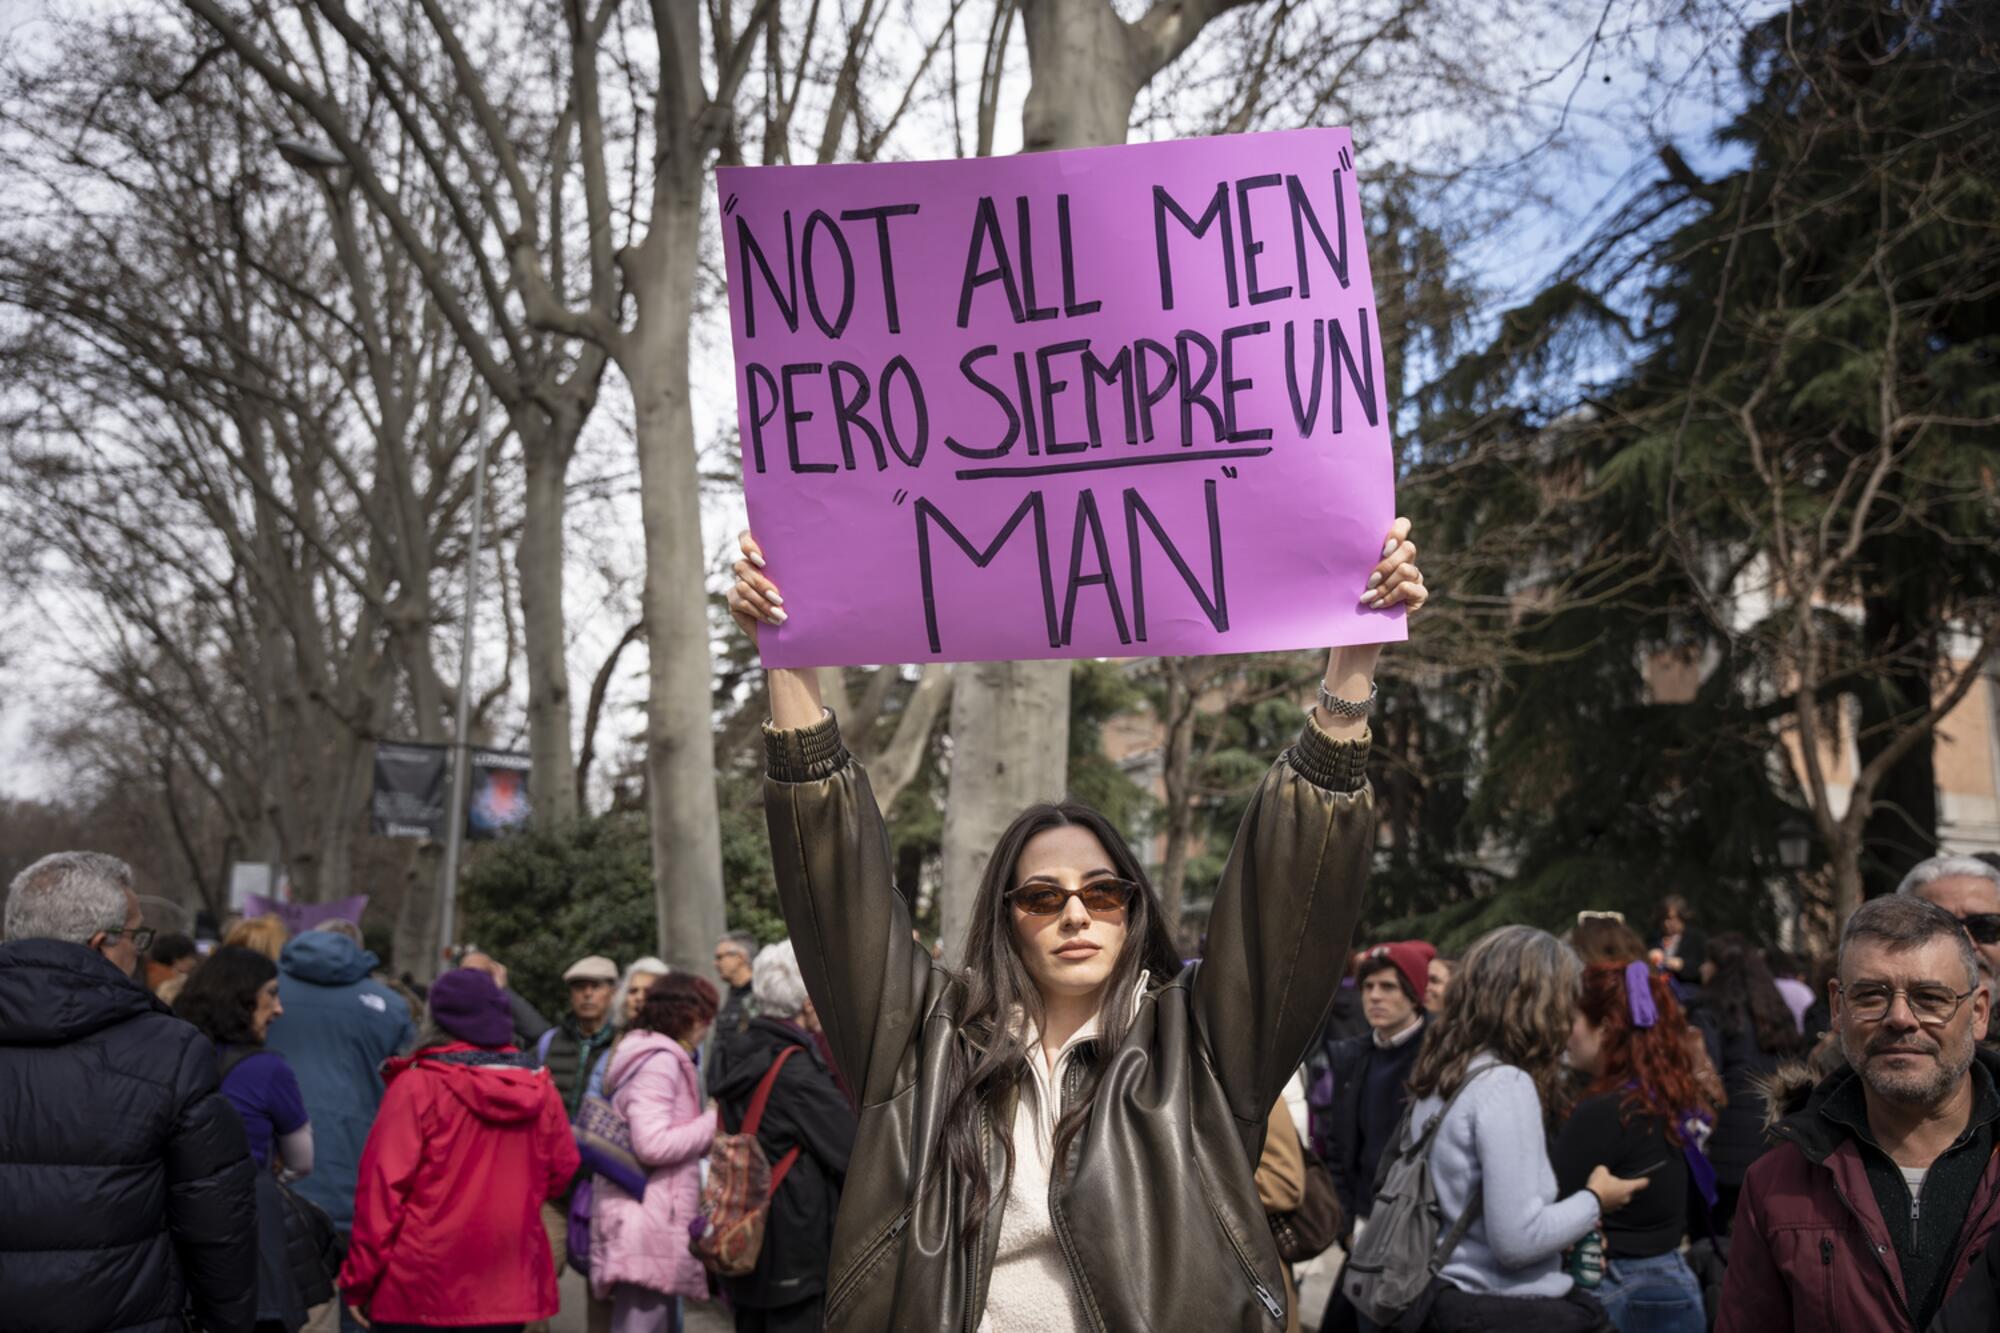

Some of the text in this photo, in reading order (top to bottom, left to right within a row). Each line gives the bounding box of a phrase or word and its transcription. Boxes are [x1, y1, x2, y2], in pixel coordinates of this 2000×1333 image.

[956, 194, 1103, 328] ALL
[744, 307, 1379, 475] PERO SIEMPRE UN
[892, 464, 1238, 655] "MAN"
